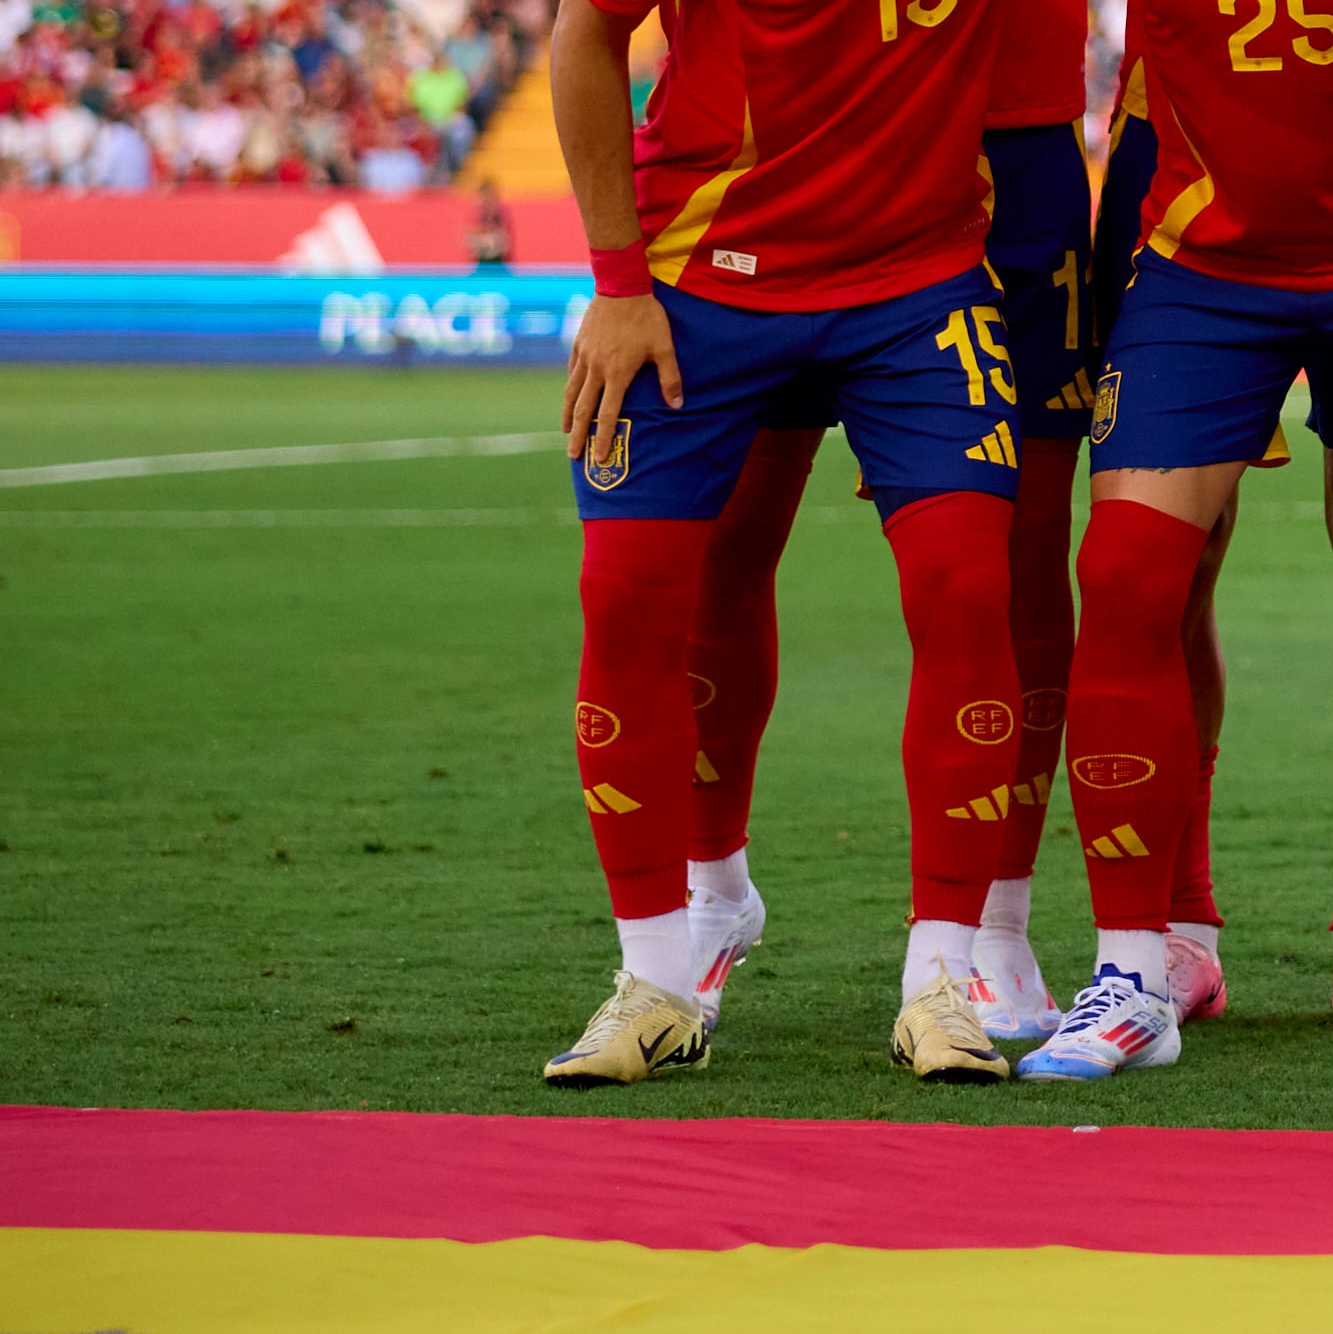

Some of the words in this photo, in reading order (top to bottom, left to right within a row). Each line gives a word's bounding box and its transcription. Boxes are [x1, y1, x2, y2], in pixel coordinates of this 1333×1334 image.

[935, 306, 1017, 405] 15
[971, 710, 1003, 721] RF
[972, 723, 1003, 734] EF
[1131, 1010, 1168, 1035] F50
